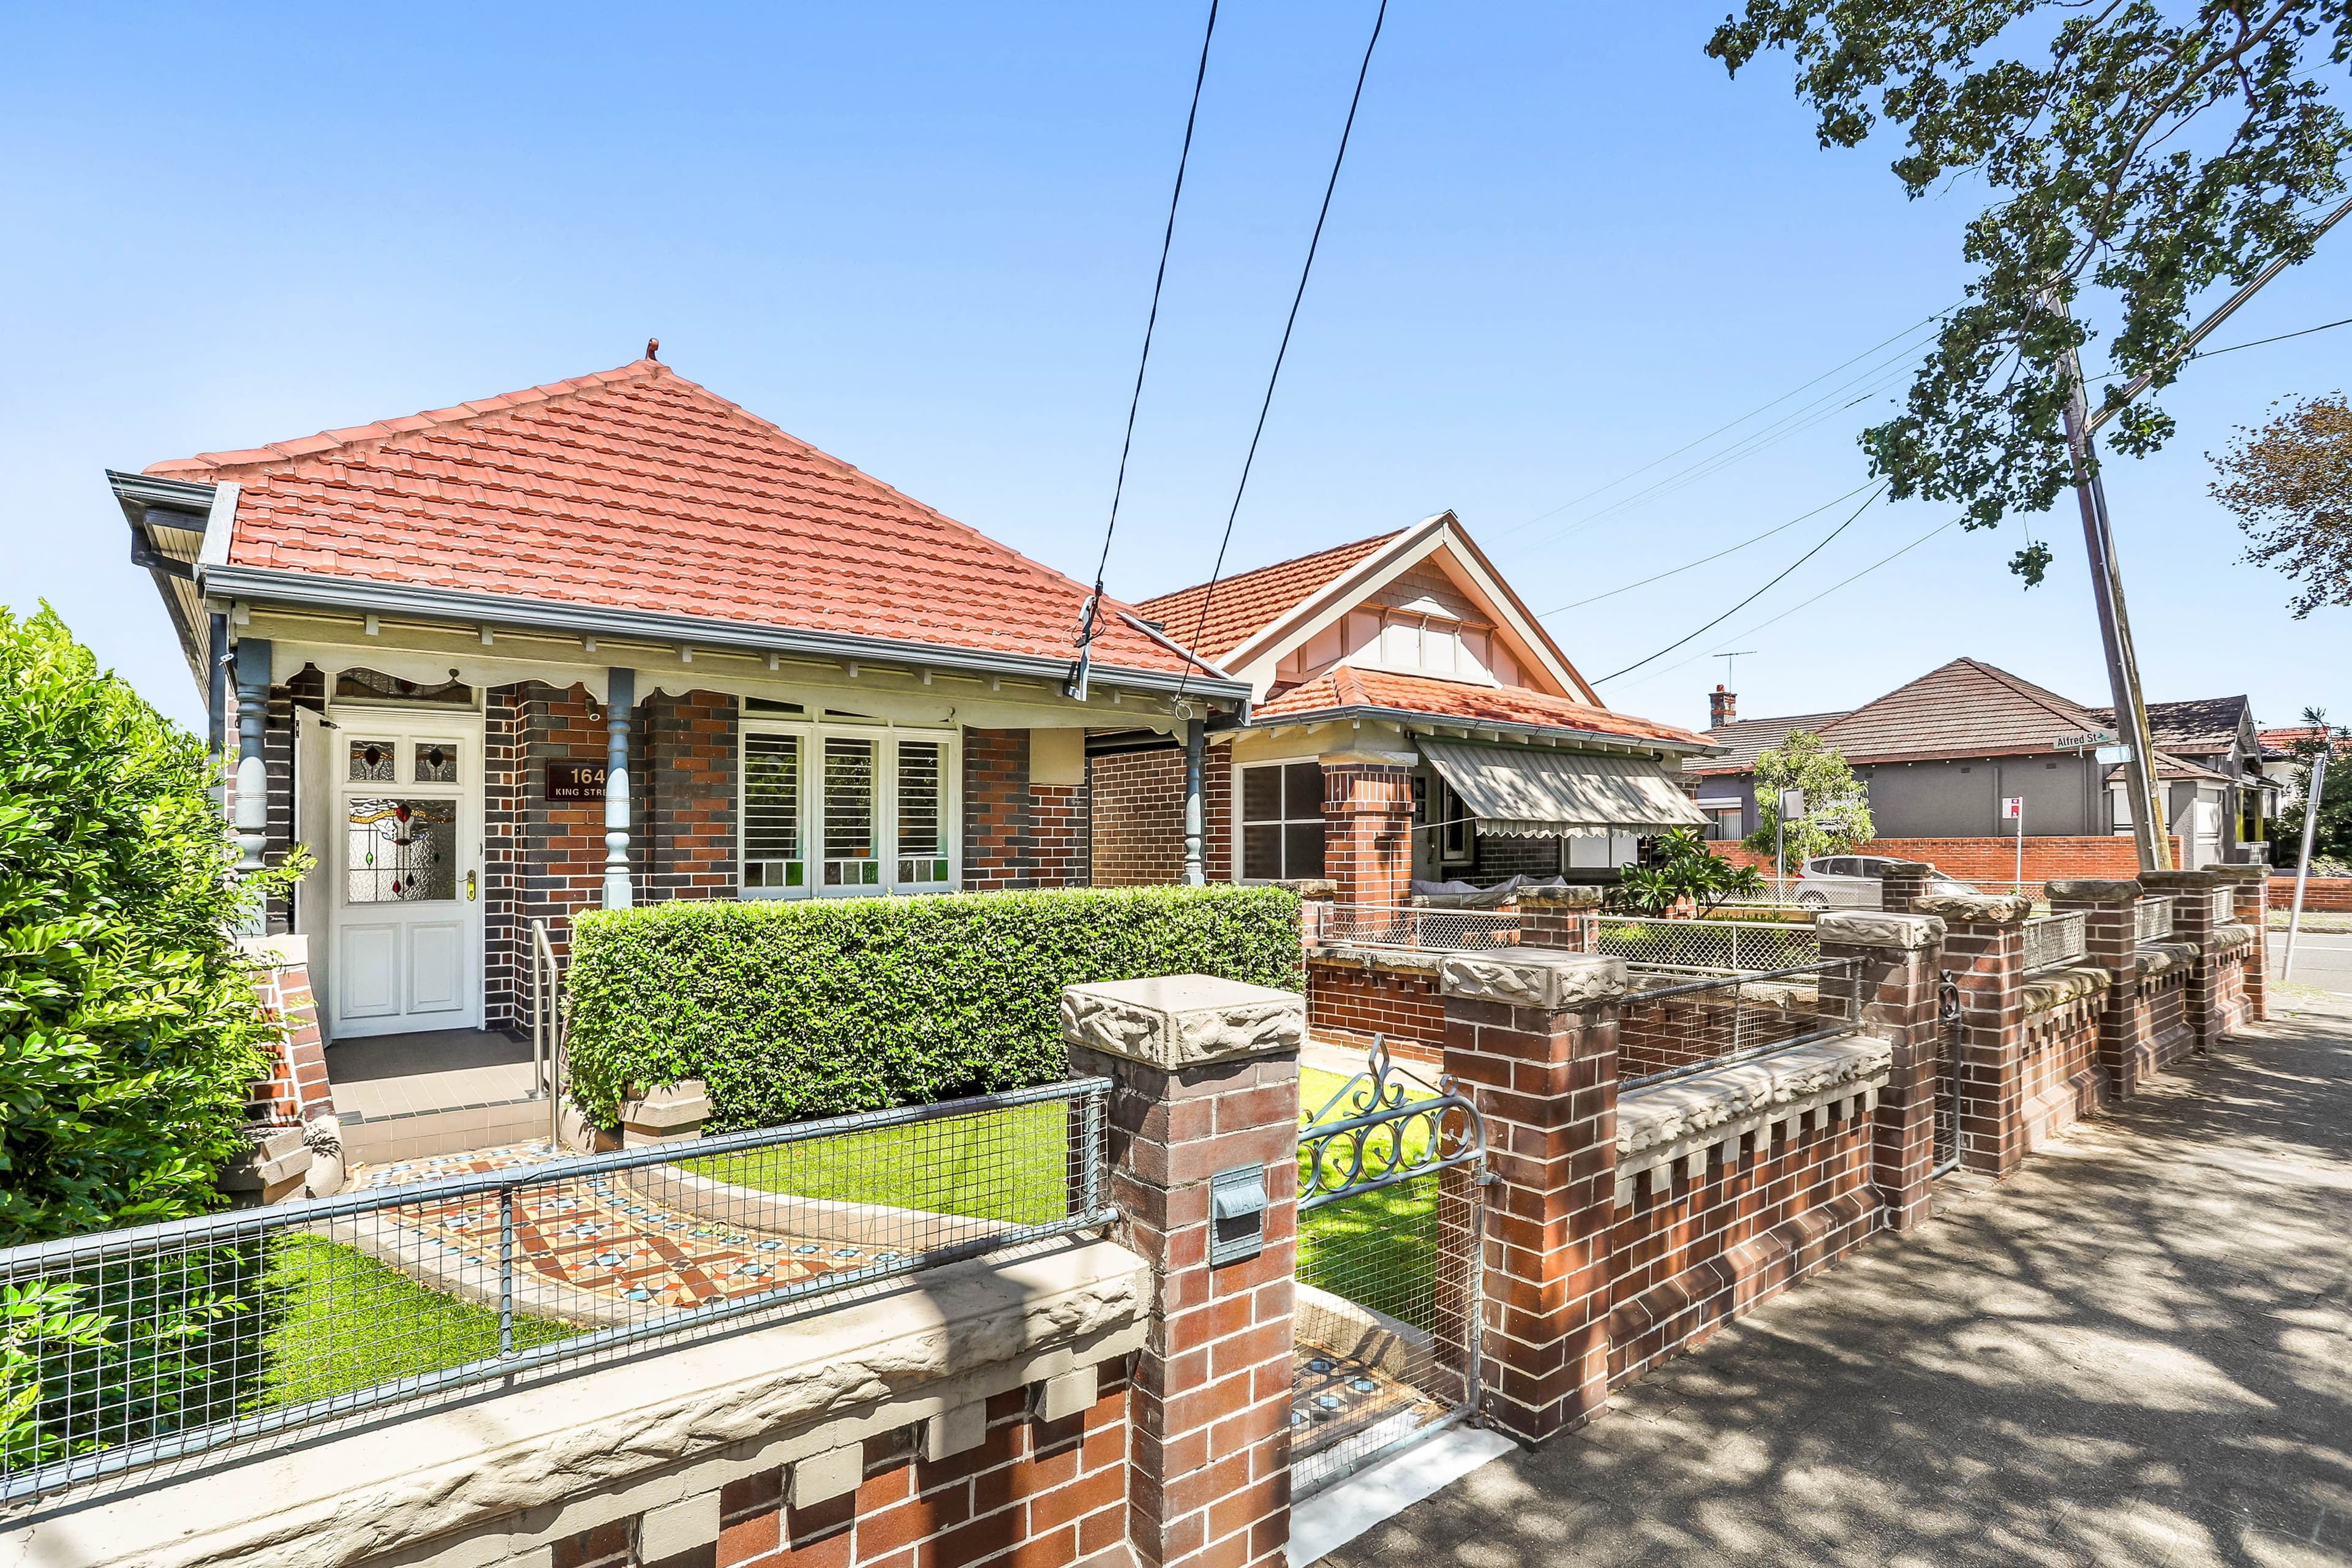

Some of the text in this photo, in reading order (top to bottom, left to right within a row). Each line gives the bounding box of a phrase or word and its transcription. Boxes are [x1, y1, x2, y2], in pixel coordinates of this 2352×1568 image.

[2057, 735, 2084, 747] Alfred
[2087, 733, 2097, 742] St
[571, 768, 605, 784] 164
[1229, 1195, 1263, 1213] MAIL
